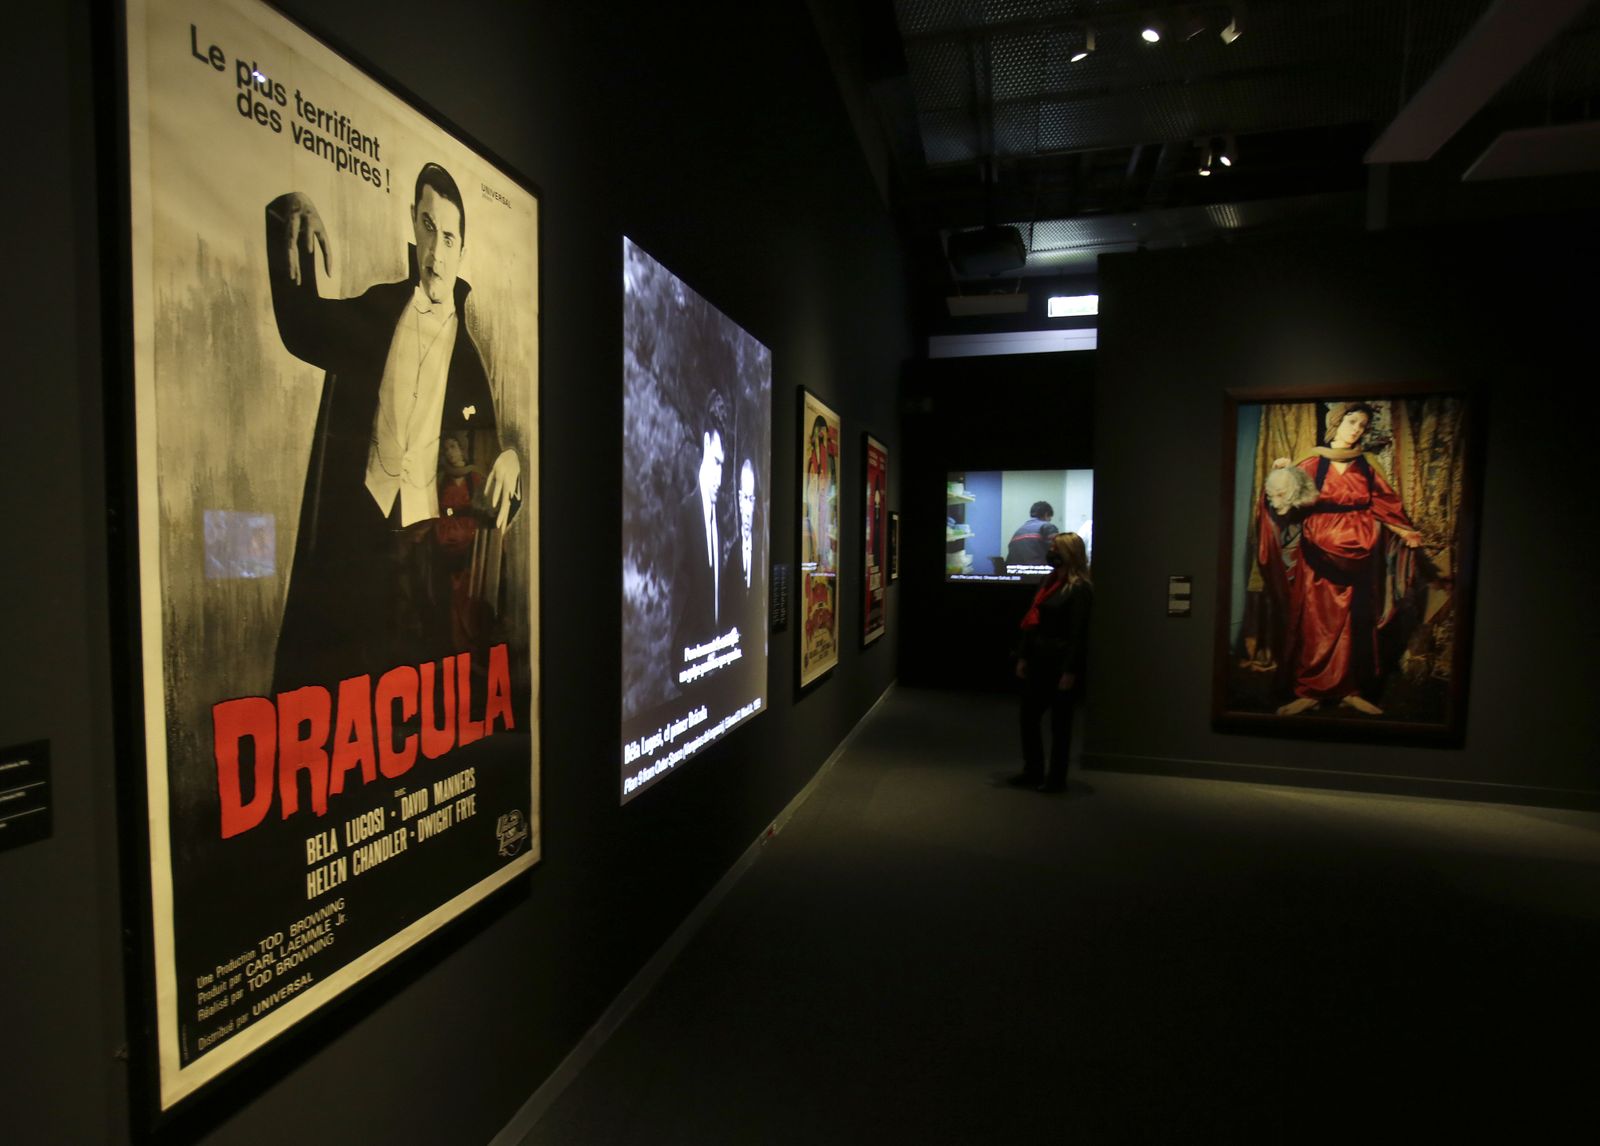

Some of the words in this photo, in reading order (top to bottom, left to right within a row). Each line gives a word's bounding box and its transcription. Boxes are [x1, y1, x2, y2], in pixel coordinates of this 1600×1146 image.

[190, 23, 226, 72] Le
[235, 58, 287, 107] plus
[294, 89, 380, 162] terrifiant
[236, 88, 282, 134] des
[290, 120, 382, 188] vampires
[212, 641, 515, 841] DRACULA
[305, 827, 339, 866] BELA
[345, 806, 385, 847] LUGOSI
[401, 787, 429, 821] DAVID
[433, 766, 476, 806] MANNERS
[306, 856, 348, 900] HELEN
[352, 827, 408, 876] CHANDLER
[417, 804, 453, 843] DWIGHT
[456, 792, 476, 823] FRYE
[197, 973, 214, 989] Une
[216, 950, 256, 978] Production
[259, 931, 284, 953] TOD
[289, 897, 345, 937] BROWNING
[245, 951, 277, 977] CARL
[280, 919, 332, 957] LAEMMLE
[247, 969, 273, 992] TOD
[275, 933, 335, 976] BROWNING
[252, 972, 314, 1016] UNIVERSAL
